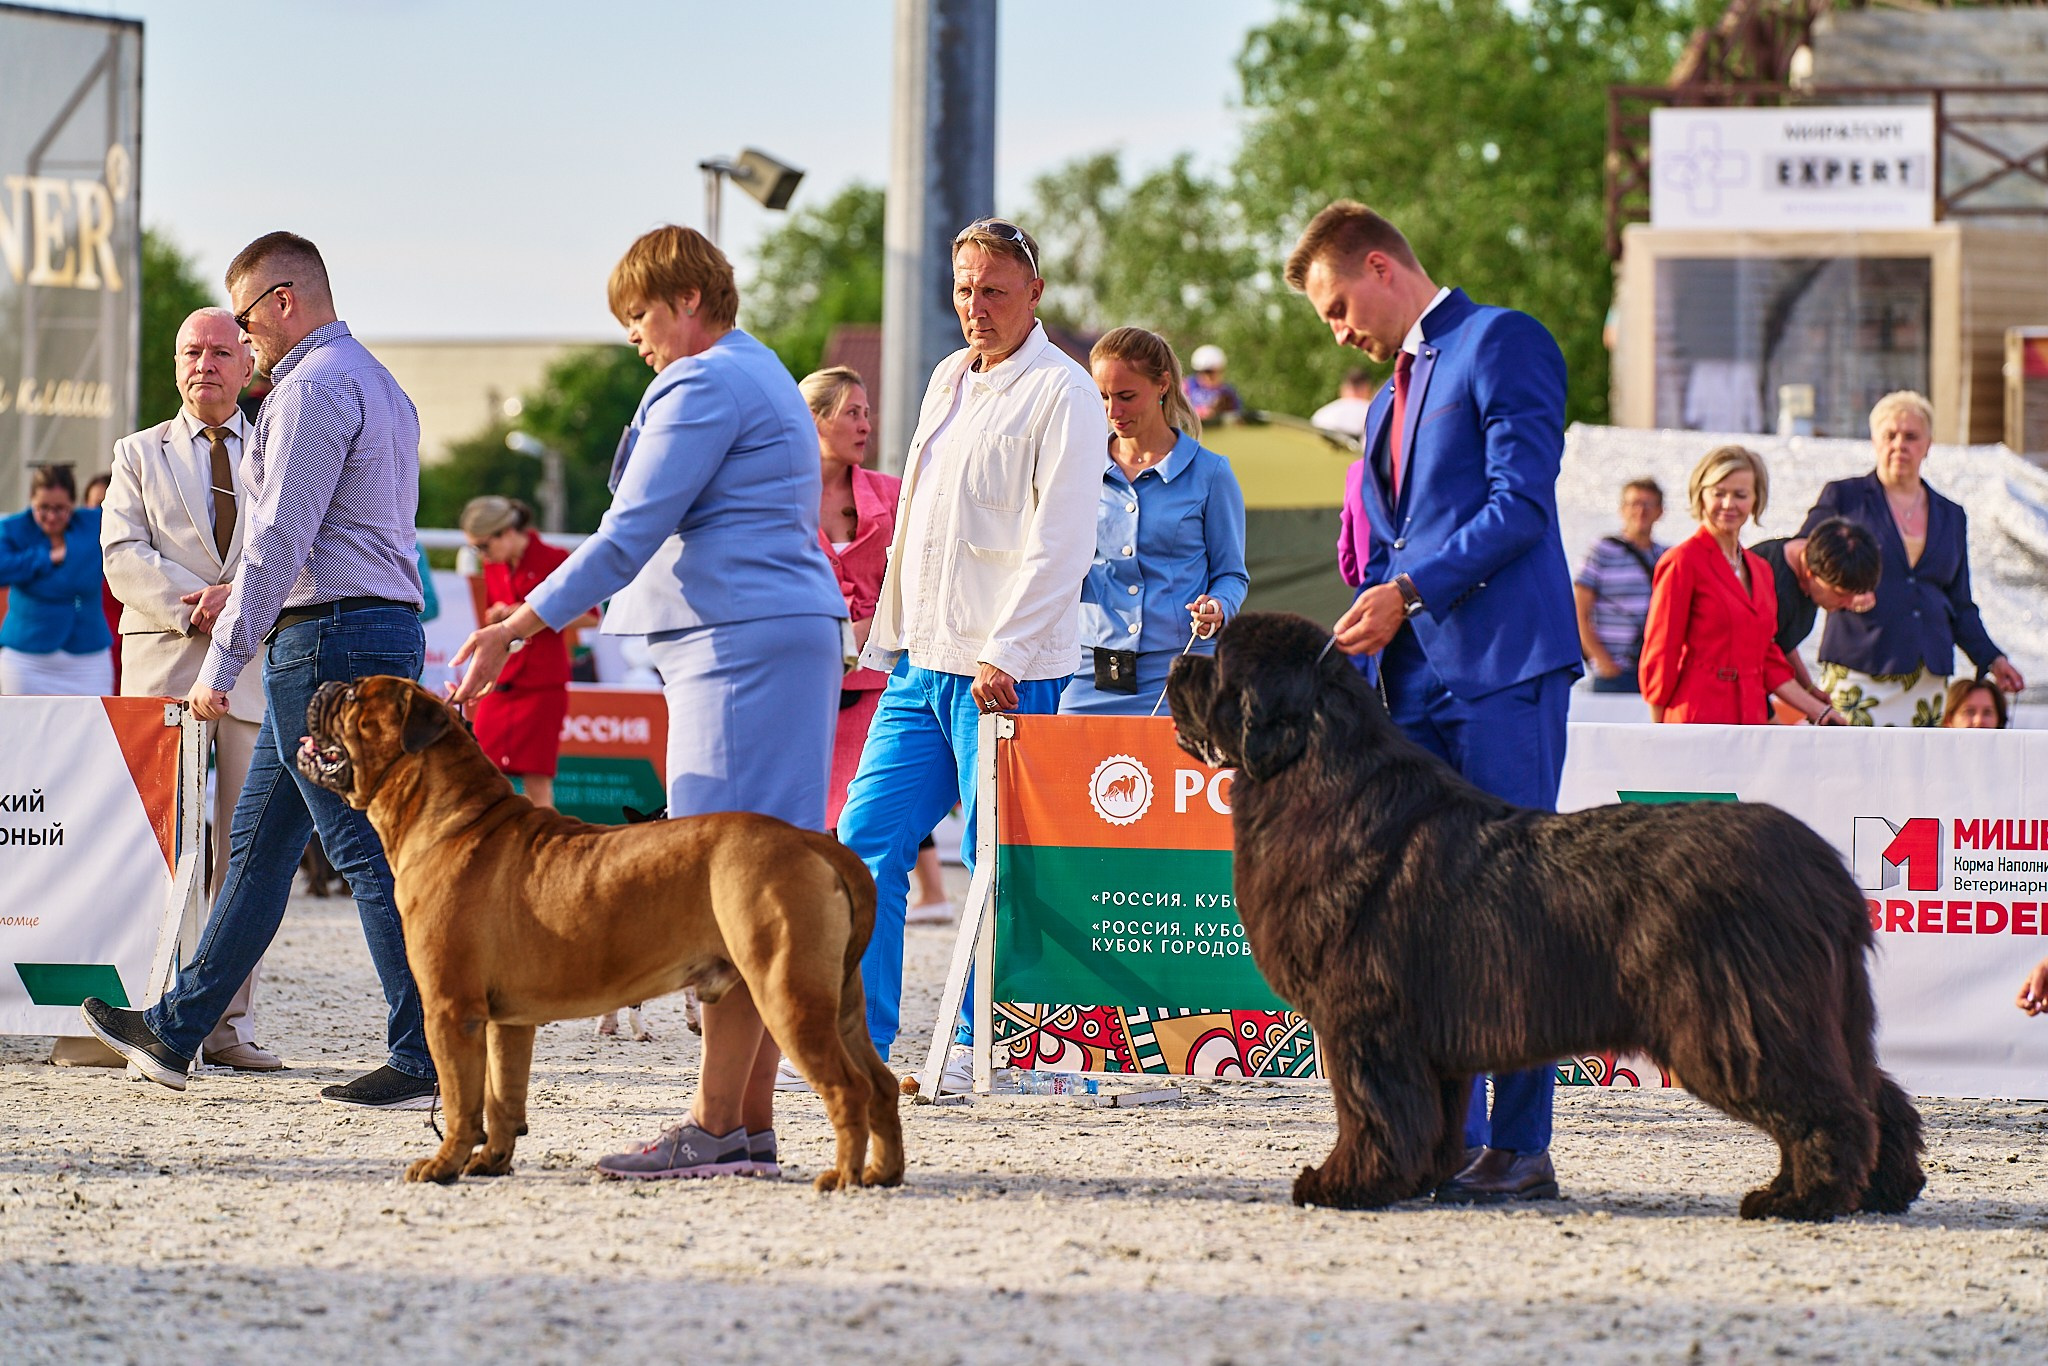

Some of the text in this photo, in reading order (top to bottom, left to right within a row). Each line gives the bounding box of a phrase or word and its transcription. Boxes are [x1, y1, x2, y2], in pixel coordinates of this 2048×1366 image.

[1777, 158, 1911, 186] EXPERT
[1953, 855, 1994, 875] Корма
[1953, 876, 2048, 896] Ветеринарн
[1091, 891, 1188, 908] «РОССИЯ.
[1863, 899, 2048, 936] BREEDE
[1091, 920, 1187, 937] «РОССИЯ.
[1092, 937, 1252, 959] КУБОК ГОРОДОВ
